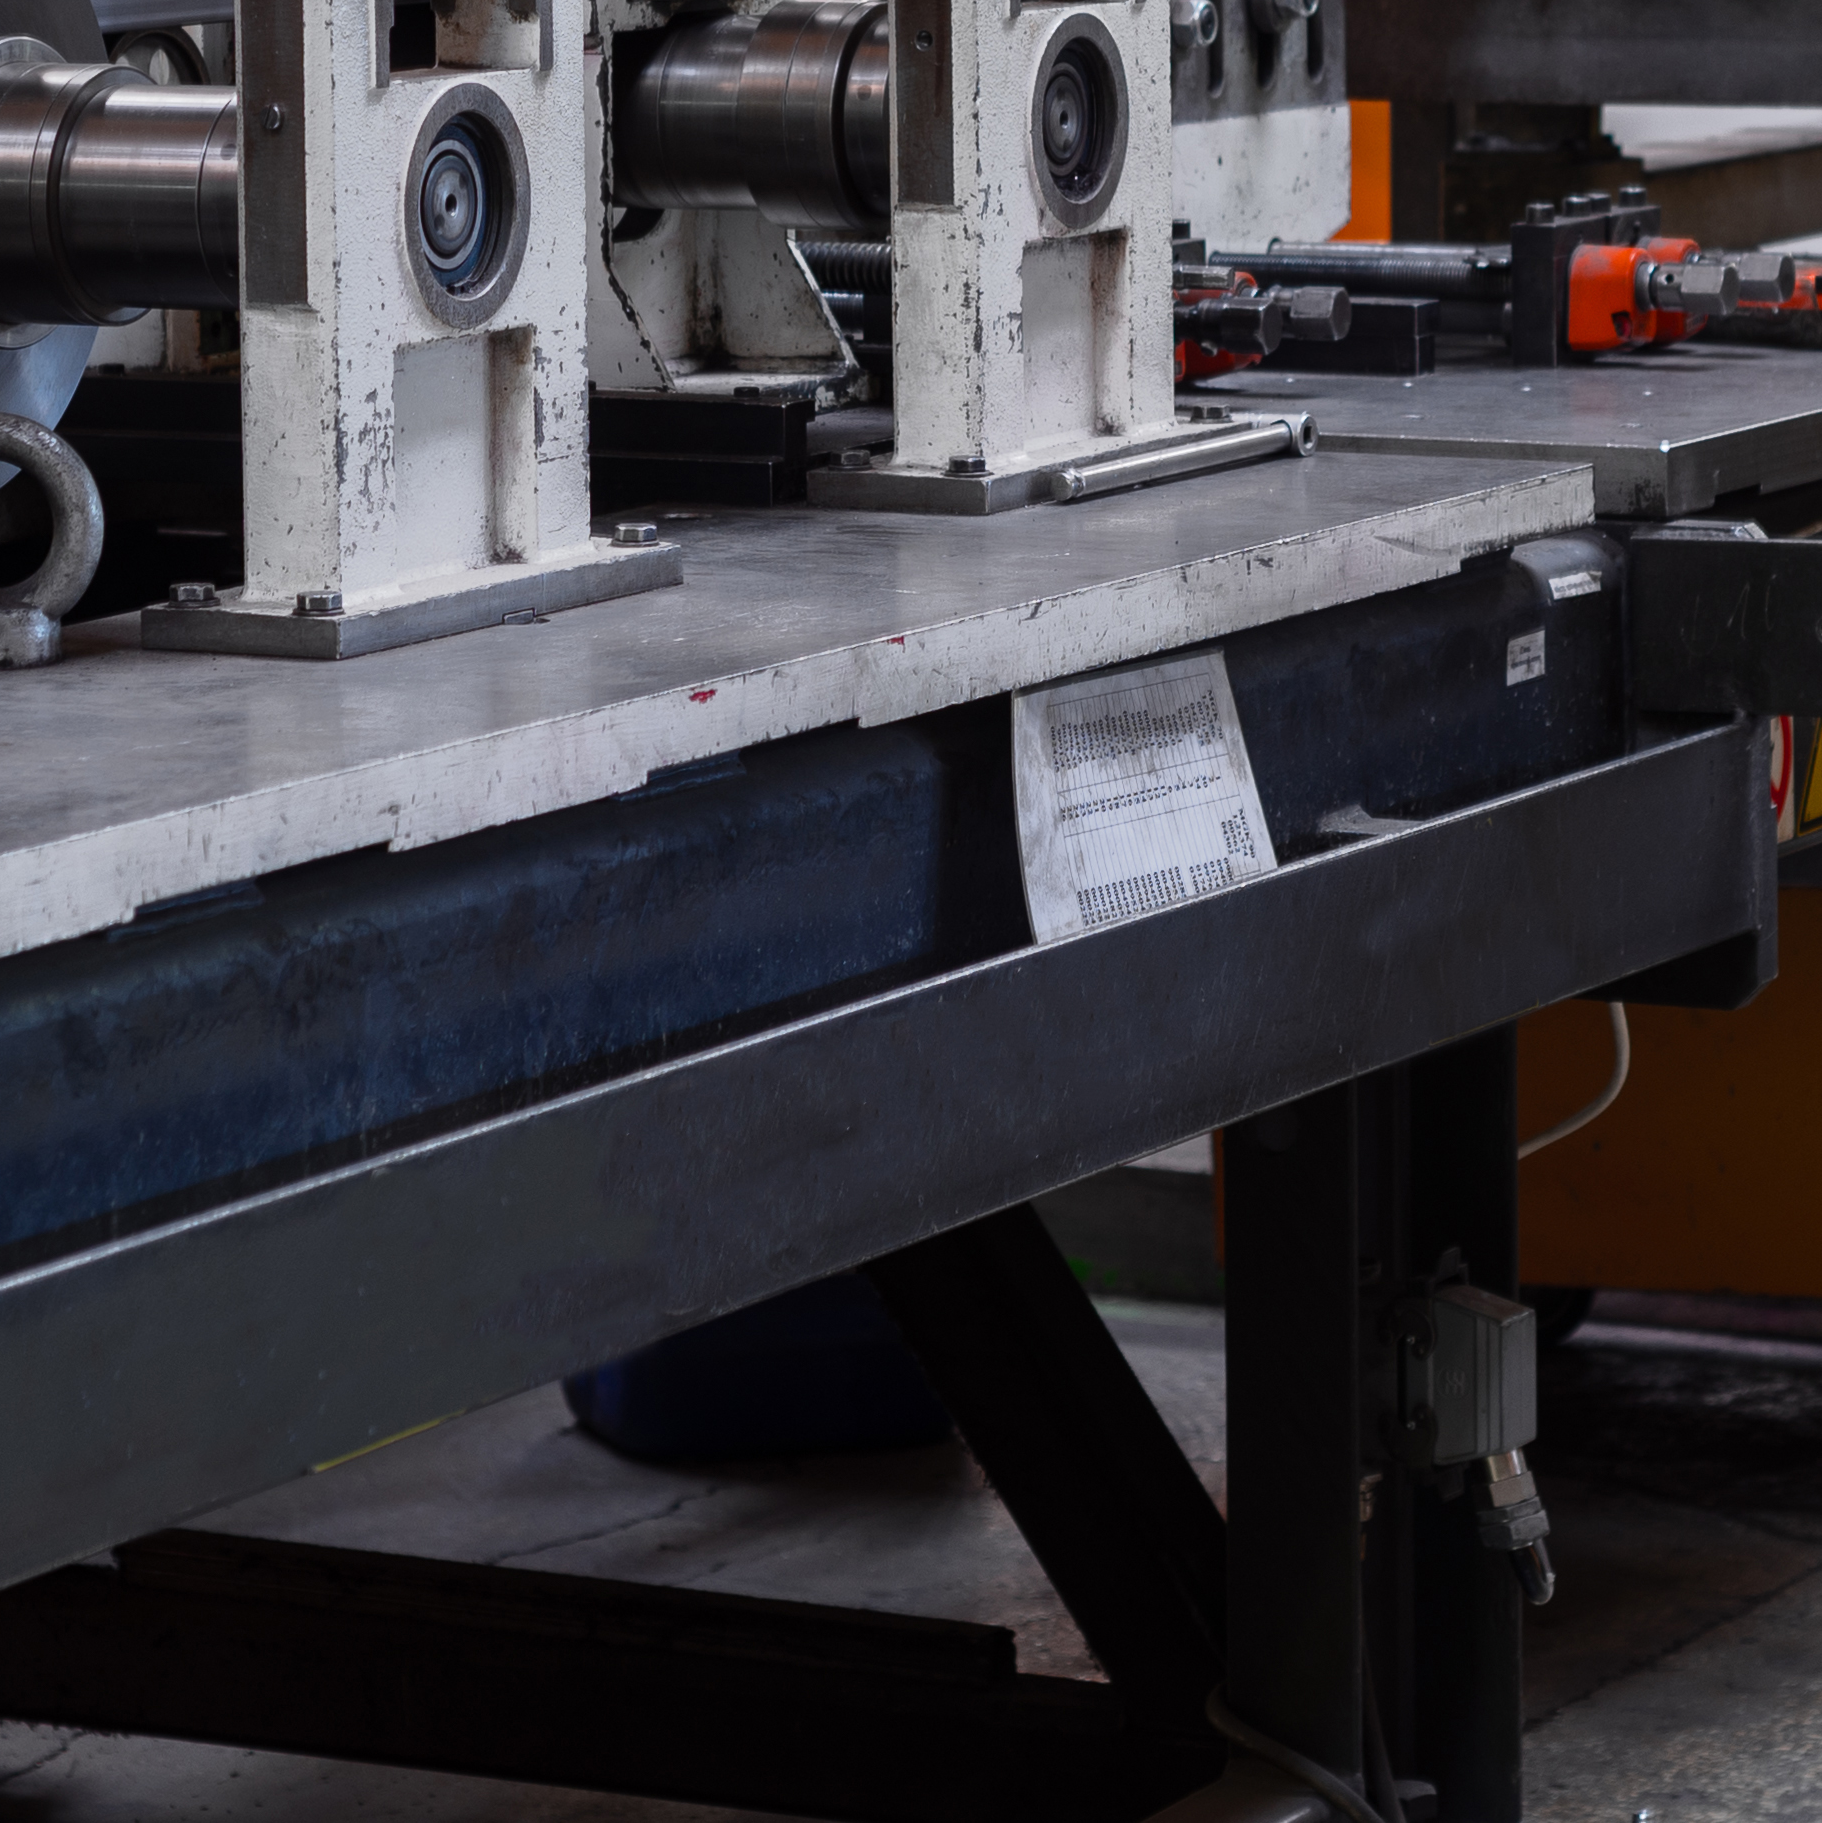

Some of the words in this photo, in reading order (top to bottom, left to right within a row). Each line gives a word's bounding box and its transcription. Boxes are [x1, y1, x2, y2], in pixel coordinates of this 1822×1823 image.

[1206, 688, 1220, 722] MGK
[1226, 819, 1240, 853] 00562
[1237, 808, 1251, 841] MGK
